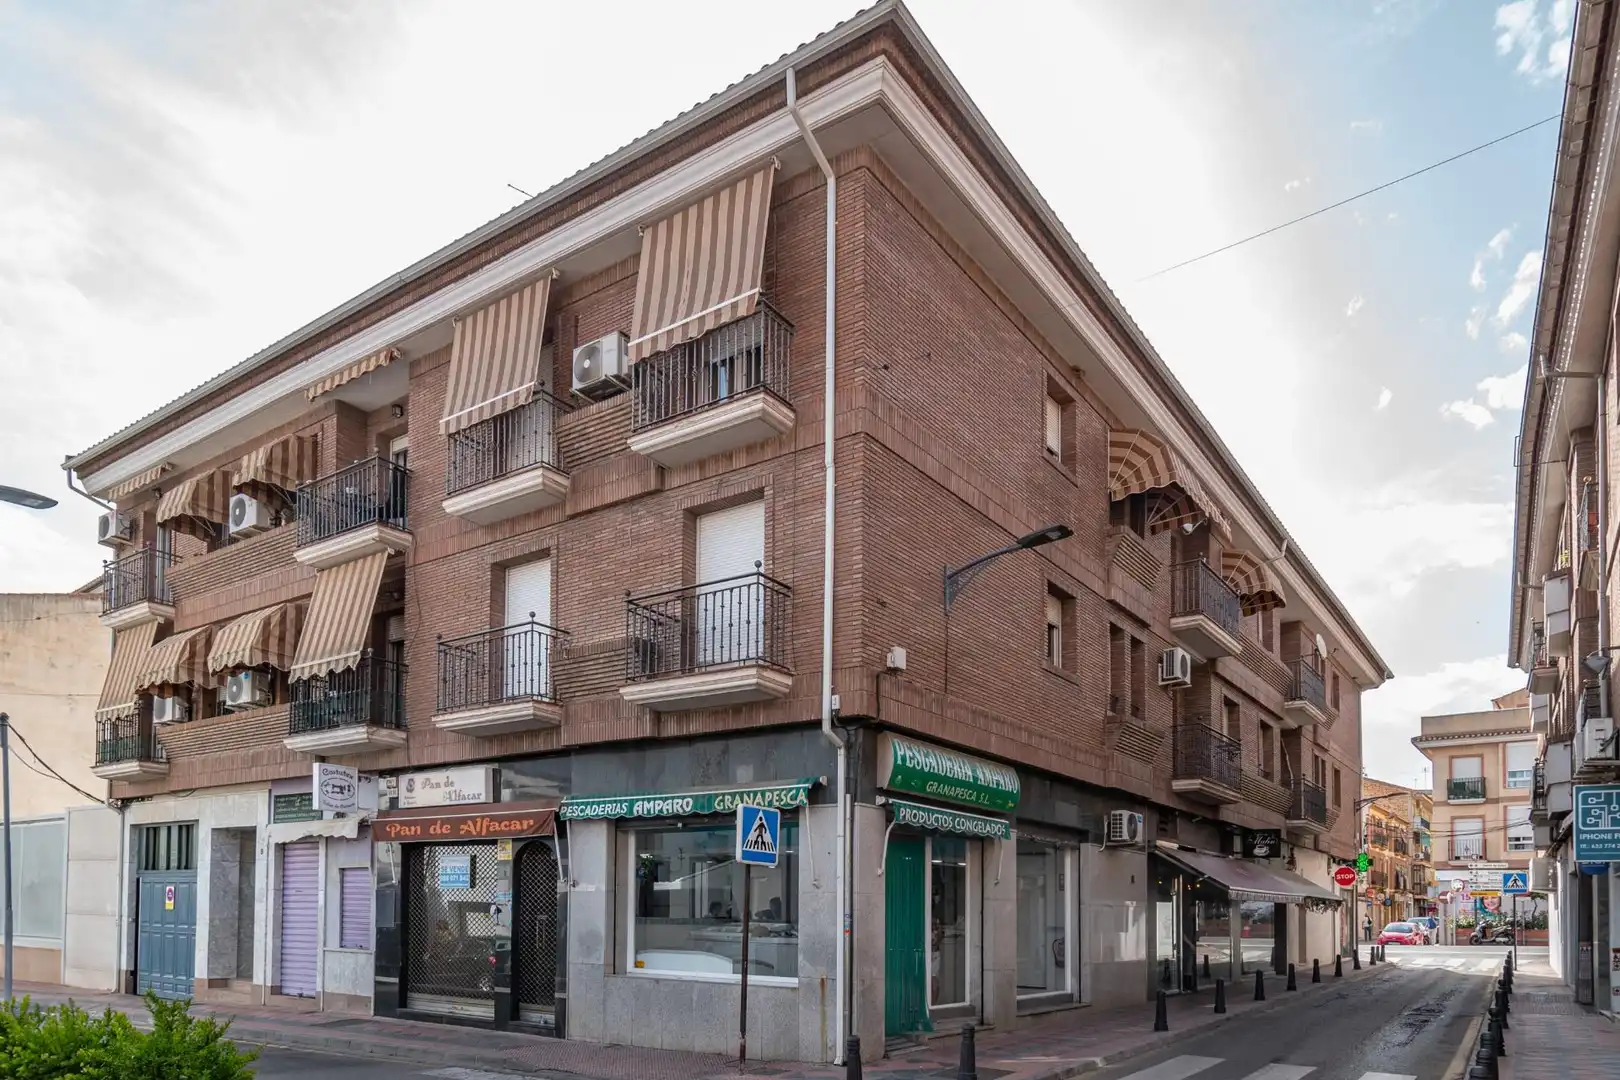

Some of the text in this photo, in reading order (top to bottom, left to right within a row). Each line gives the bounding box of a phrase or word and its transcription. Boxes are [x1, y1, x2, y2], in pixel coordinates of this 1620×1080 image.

[893, 738, 1019, 794] PESCADERIA AMPARO
[420, 776, 455, 789] Pan de
[925, 781, 977, 801] GRANAPESCA
[443, 789, 482, 802] Alfacar
[560, 787, 808, 817] PESCADERIAS AMPARO GRANAPESCA
[385, 817, 534, 838] Pan de Alfacar
[899, 807, 1006, 837] PRODUCTOS CONGELADOS
